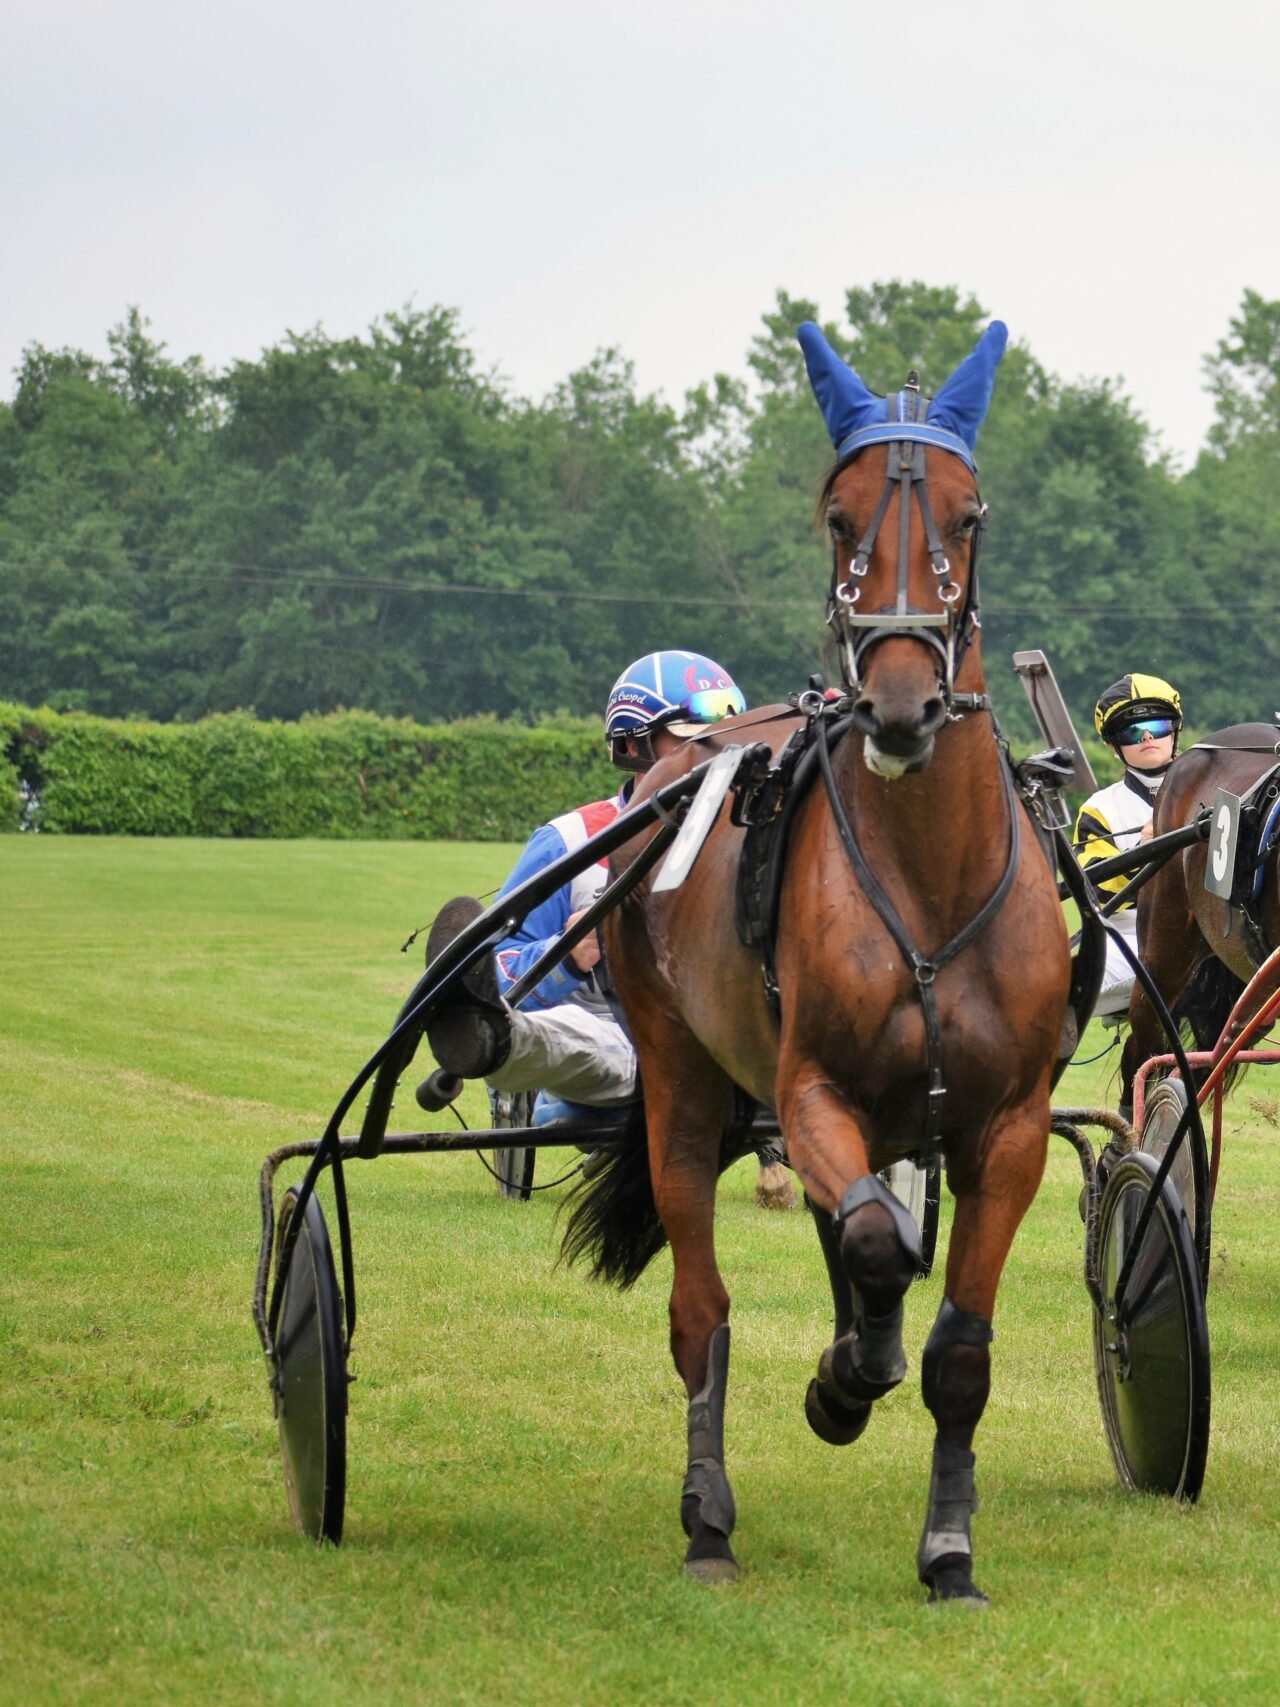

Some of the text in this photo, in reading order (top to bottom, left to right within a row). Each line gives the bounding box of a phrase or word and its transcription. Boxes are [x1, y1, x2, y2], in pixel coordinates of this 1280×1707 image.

[700, 679, 726, 690] D C
[1212, 805, 1231, 881] 3
